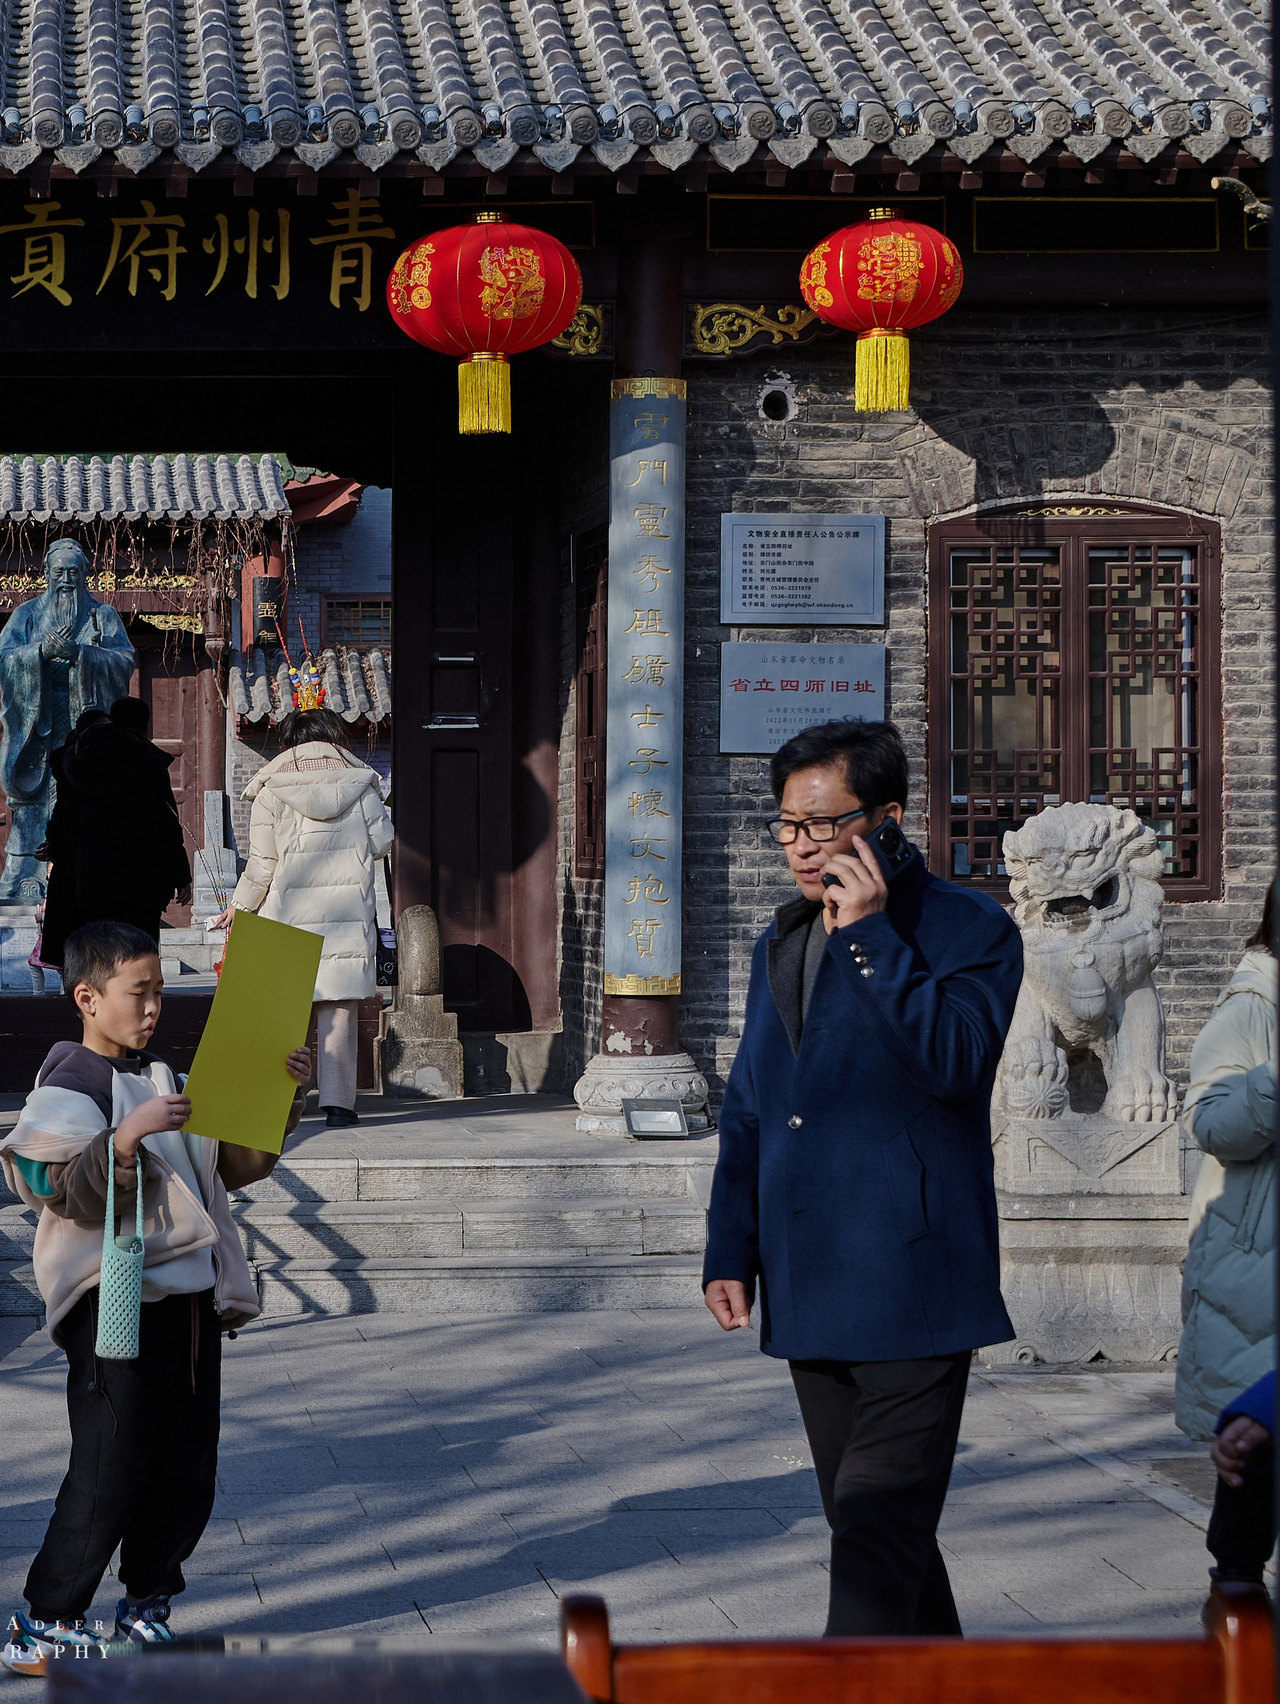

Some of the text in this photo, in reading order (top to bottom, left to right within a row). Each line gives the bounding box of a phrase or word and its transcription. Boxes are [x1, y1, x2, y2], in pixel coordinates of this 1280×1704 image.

[747, 530, 860, 539] 文物安全直接责任人公告公示牌
[761, 655, 845, 664] 山东省革命文物名录
[728, 678, 876, 693] 省立四师旧址
